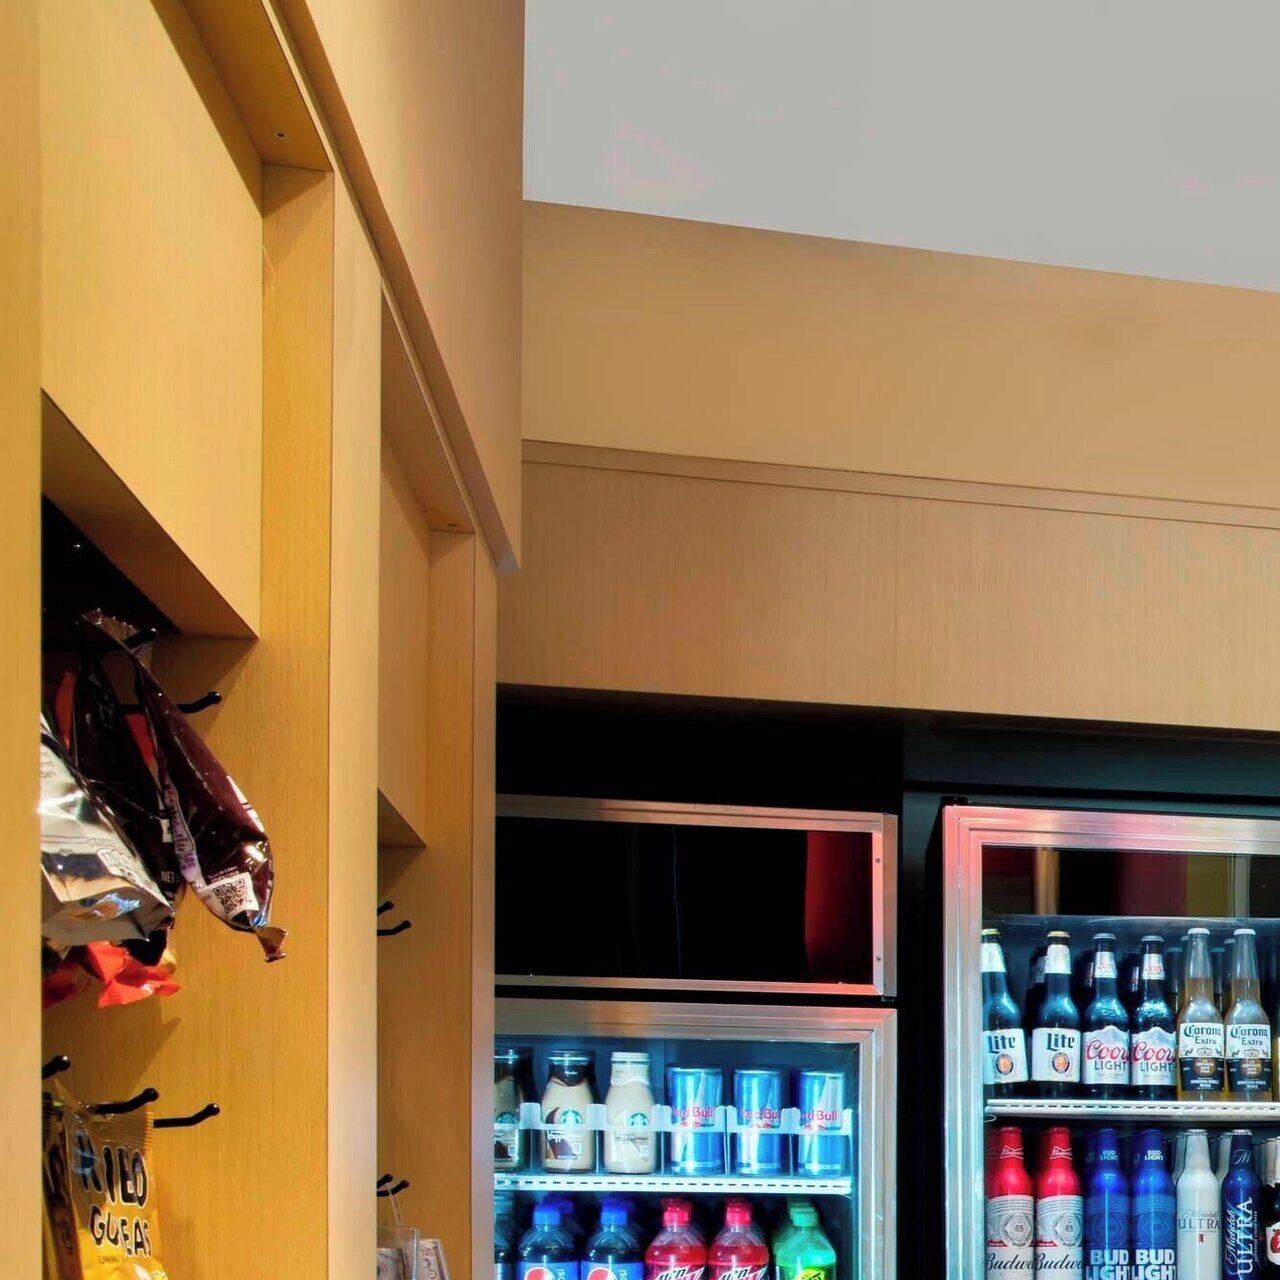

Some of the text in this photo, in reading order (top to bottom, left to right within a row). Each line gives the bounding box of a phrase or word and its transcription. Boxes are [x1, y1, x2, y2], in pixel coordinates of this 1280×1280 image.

[1184, 1025, 1222, 1037] Corona
[1230, 1025, 1268, 1038] Corona
[985, 1035, 1016, 1053] Lite
[1046, 1032, 1075, 1052] Lite
[1086, 1039, 1129, 1062] Coor
[1132, 1040, 1175, 1063] Coor
[692, 1107, 713, 1118] Bull
[817, 1111, 837, 1121] Bull
[1178, 1217, 1222, 1230] ULTRA
[1236, 1197, 1253, 1274] ULTRA
[1090, 1249, 1129, 1265] BUD
[1135, 1249, 1175, 1265] BUD
